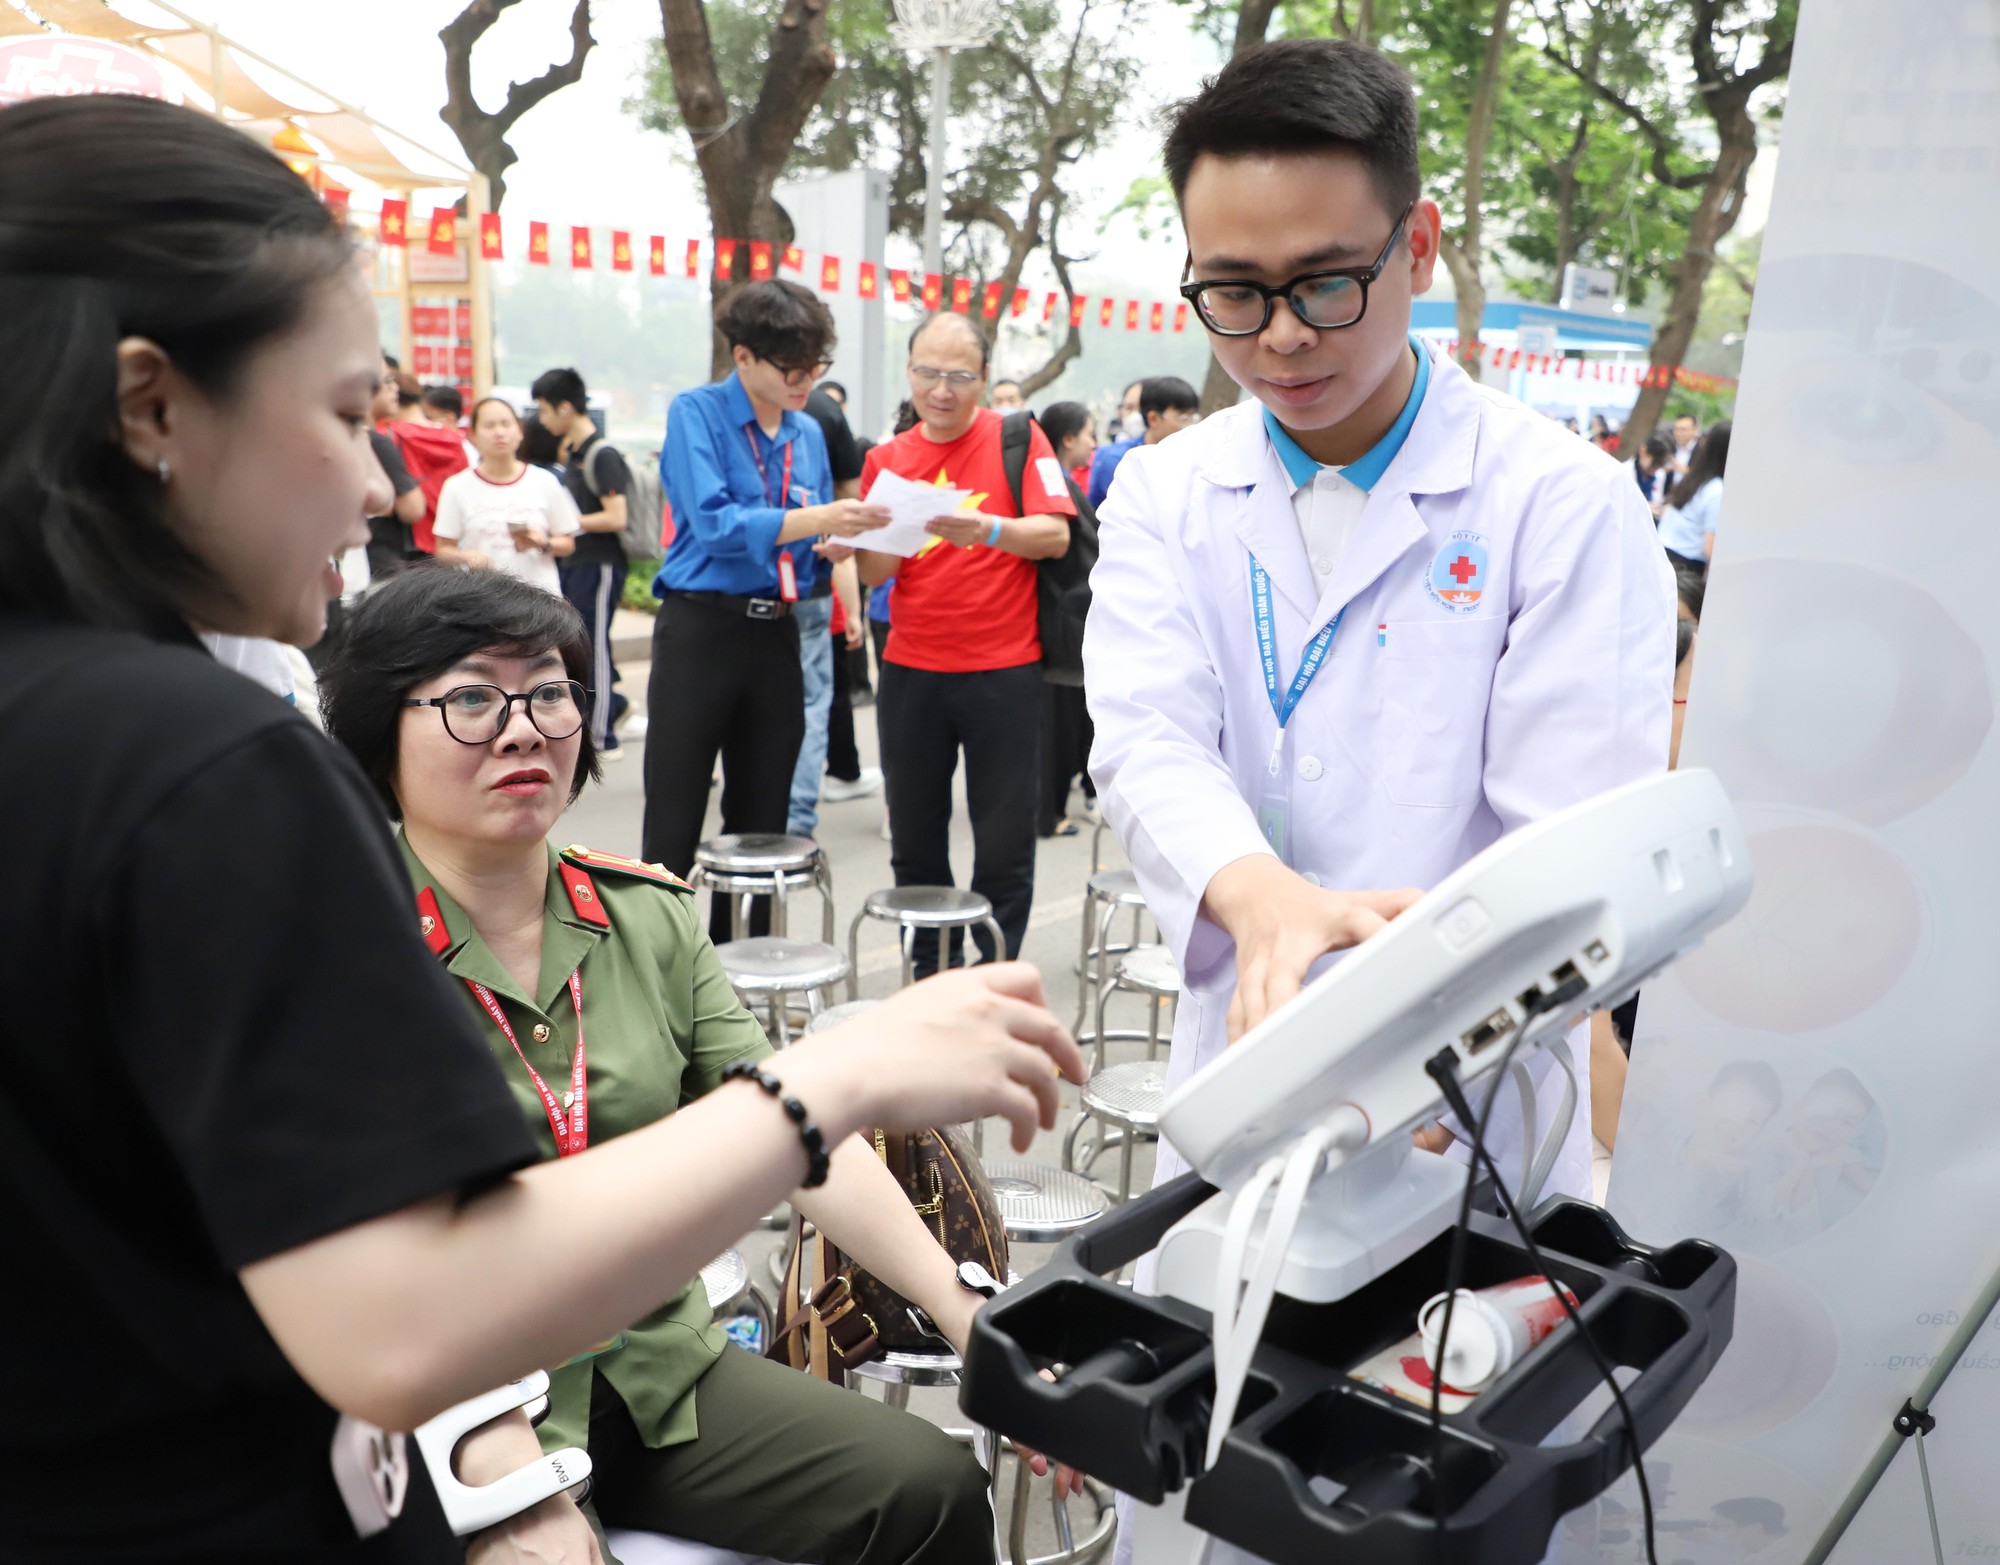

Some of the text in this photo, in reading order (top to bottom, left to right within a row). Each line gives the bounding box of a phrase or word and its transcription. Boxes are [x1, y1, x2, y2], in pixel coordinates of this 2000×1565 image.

[1256, 596, 1268, 619] TOÀN
[1262, 642, 1272, 656] ĐẠI
[1295, 677, 1307, 690] ĐẠI
[1302, 662, 1316, 676] HỘI
[1310, 646, 1323, 661] ĐẠI
[545, 1093, 555, 1106] ĐẠI
[575, 1088, 584, 1100] ĐẠI
[551, 1107, 562, 1121] HỘI
[572, 1103, 585, 1116] HỘI
[557, 1121, 567, 1136] ĐẠI
[574, 1118, 585, 1132] ĐẠI
